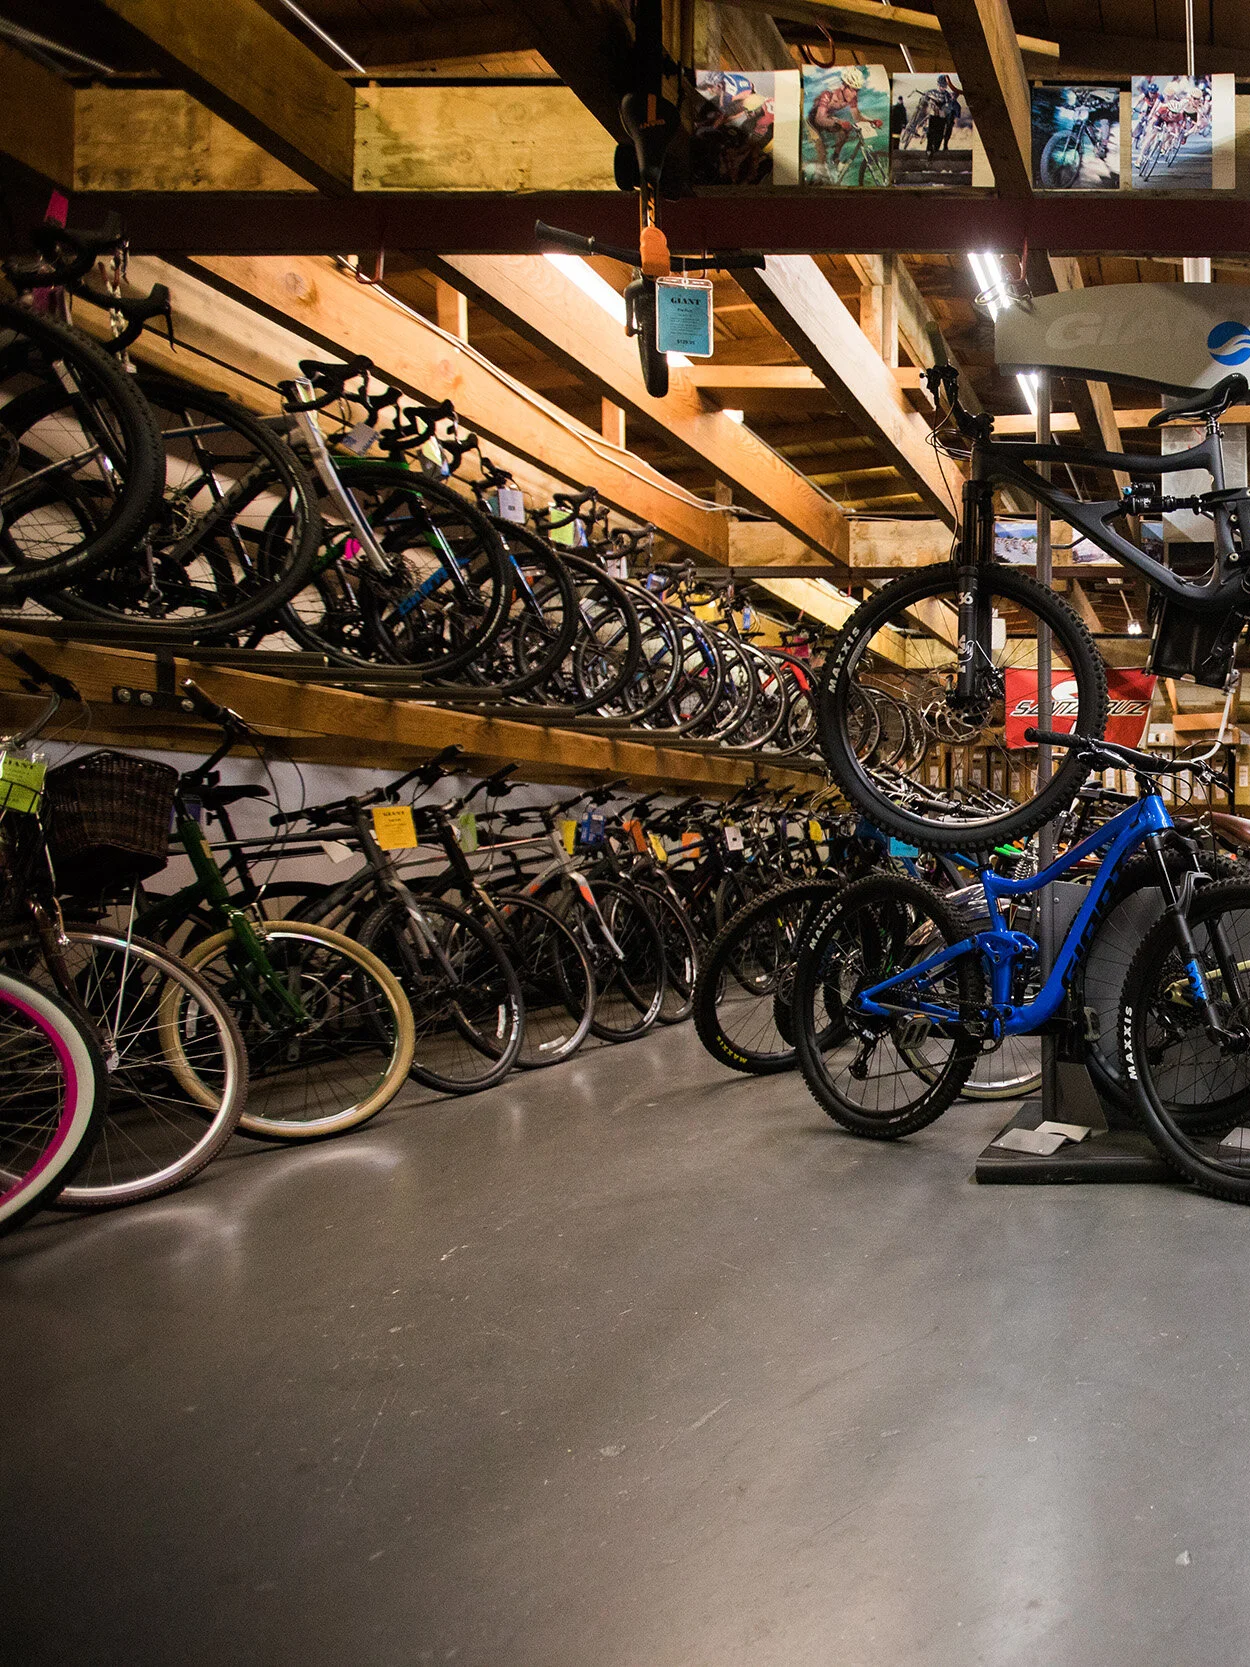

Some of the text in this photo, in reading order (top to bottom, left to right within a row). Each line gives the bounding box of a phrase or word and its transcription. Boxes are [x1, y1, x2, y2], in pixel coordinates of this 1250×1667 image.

[670, 297, 702, 306] GIANT
[958, 591, 974, 605] 36
[828, 626, 860, 695] MAXXIS
[809, 903, 843, 950] MAXXIS
[1184, 959, 1208, 1003] FOX
[716, 1035, 748, 1064] MAXXIS
[1123, 1006, 1138, 1081] MAXXIS
